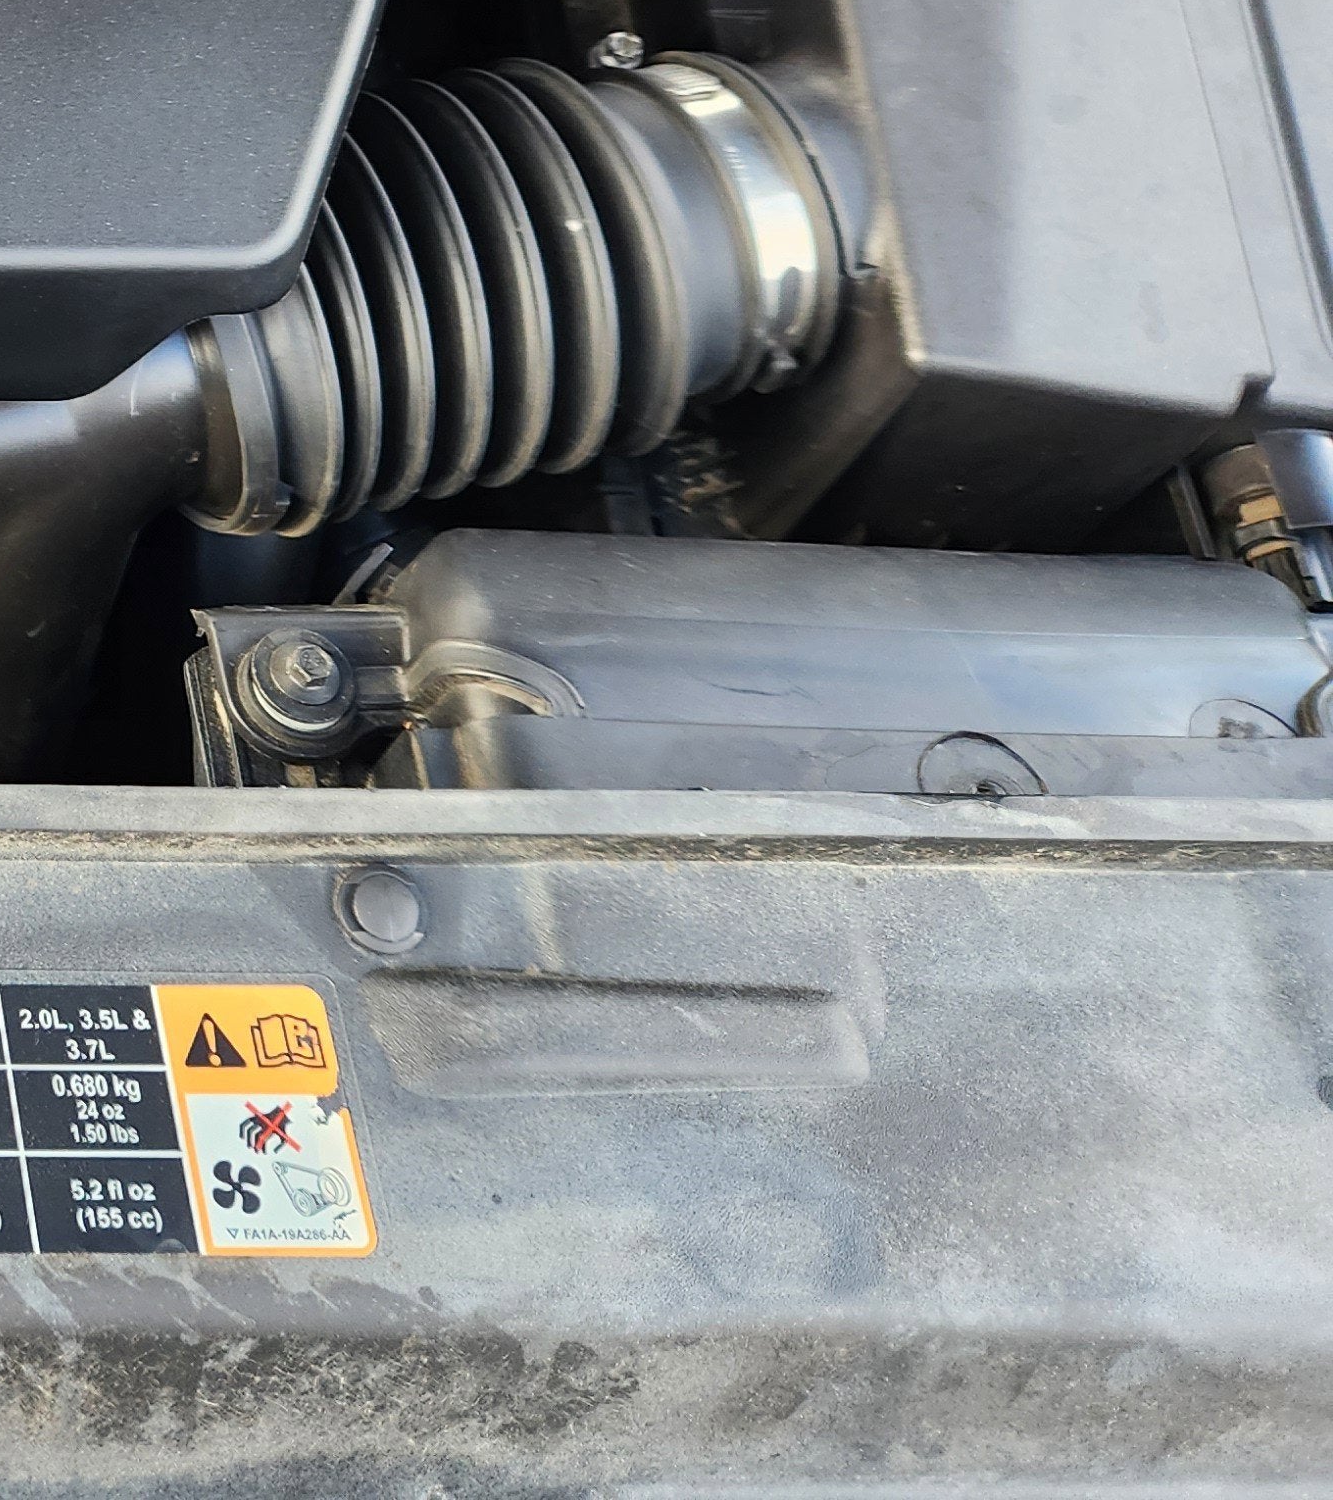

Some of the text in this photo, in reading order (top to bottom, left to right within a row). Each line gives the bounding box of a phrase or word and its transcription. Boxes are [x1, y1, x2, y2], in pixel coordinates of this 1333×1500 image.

[19, 1008, 152, 1033] 2.0L, 3.5L &
[65, 1038, 116, 1061] 3.7L
[51, 1073, 142, 1102] 0.680 kg
[75, 1099, 125, 1120] 24 oz
[70, 1122, 139, 1144] 1.50 lbs
[70, 1178, 156, 1201] 5.2 fl oz
[75, 1206, 163, 1234] (155 cc)
[243, 1228, 351, 1240] FA1A-19A286-AA
